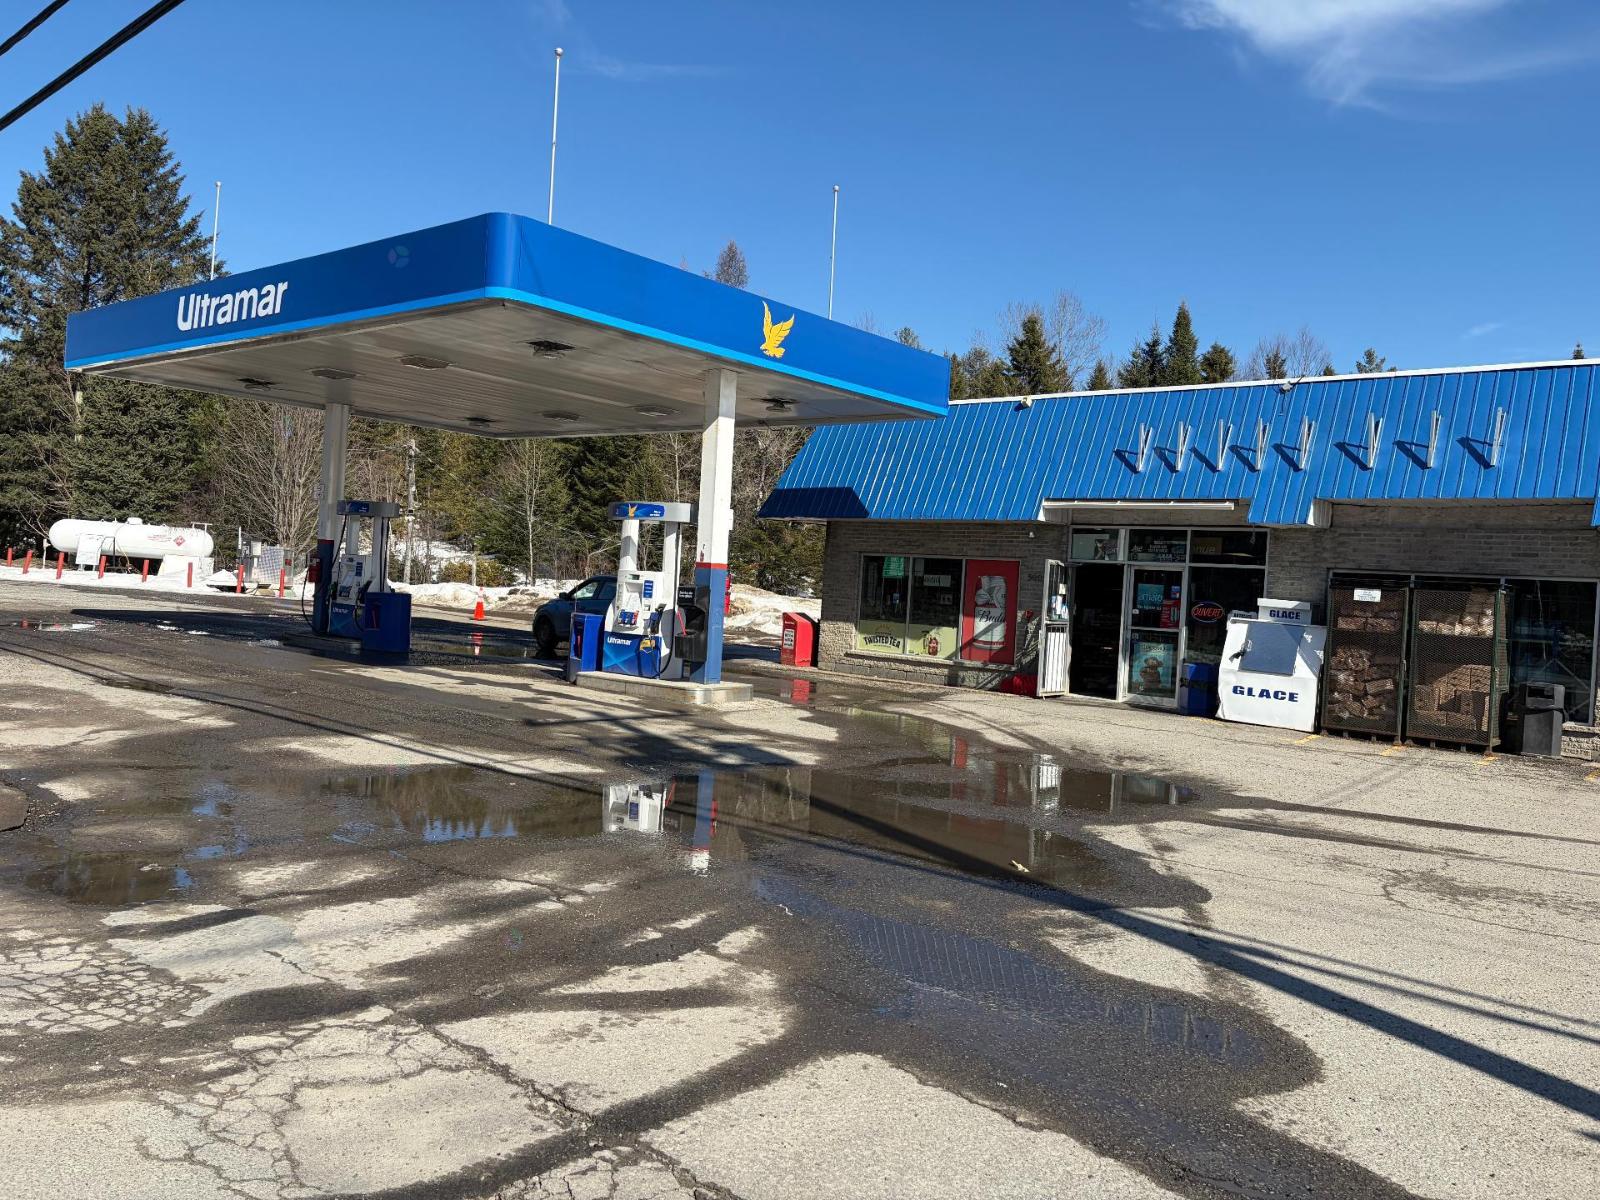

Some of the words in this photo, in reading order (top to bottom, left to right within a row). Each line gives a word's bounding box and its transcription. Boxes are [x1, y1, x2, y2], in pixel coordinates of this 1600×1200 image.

[177, 281, 288, 331] Ultramar
[1193, 606, 1223, 618] OUVERT
[1269, 609, 1301, 620] GLACE
[607, 636, 632, 646] Ultramar
[863, 634, 889, 645] TWISTED
[889, 635, 901, 649] TEA
[1231, 685, 1299, 702] GLACE
